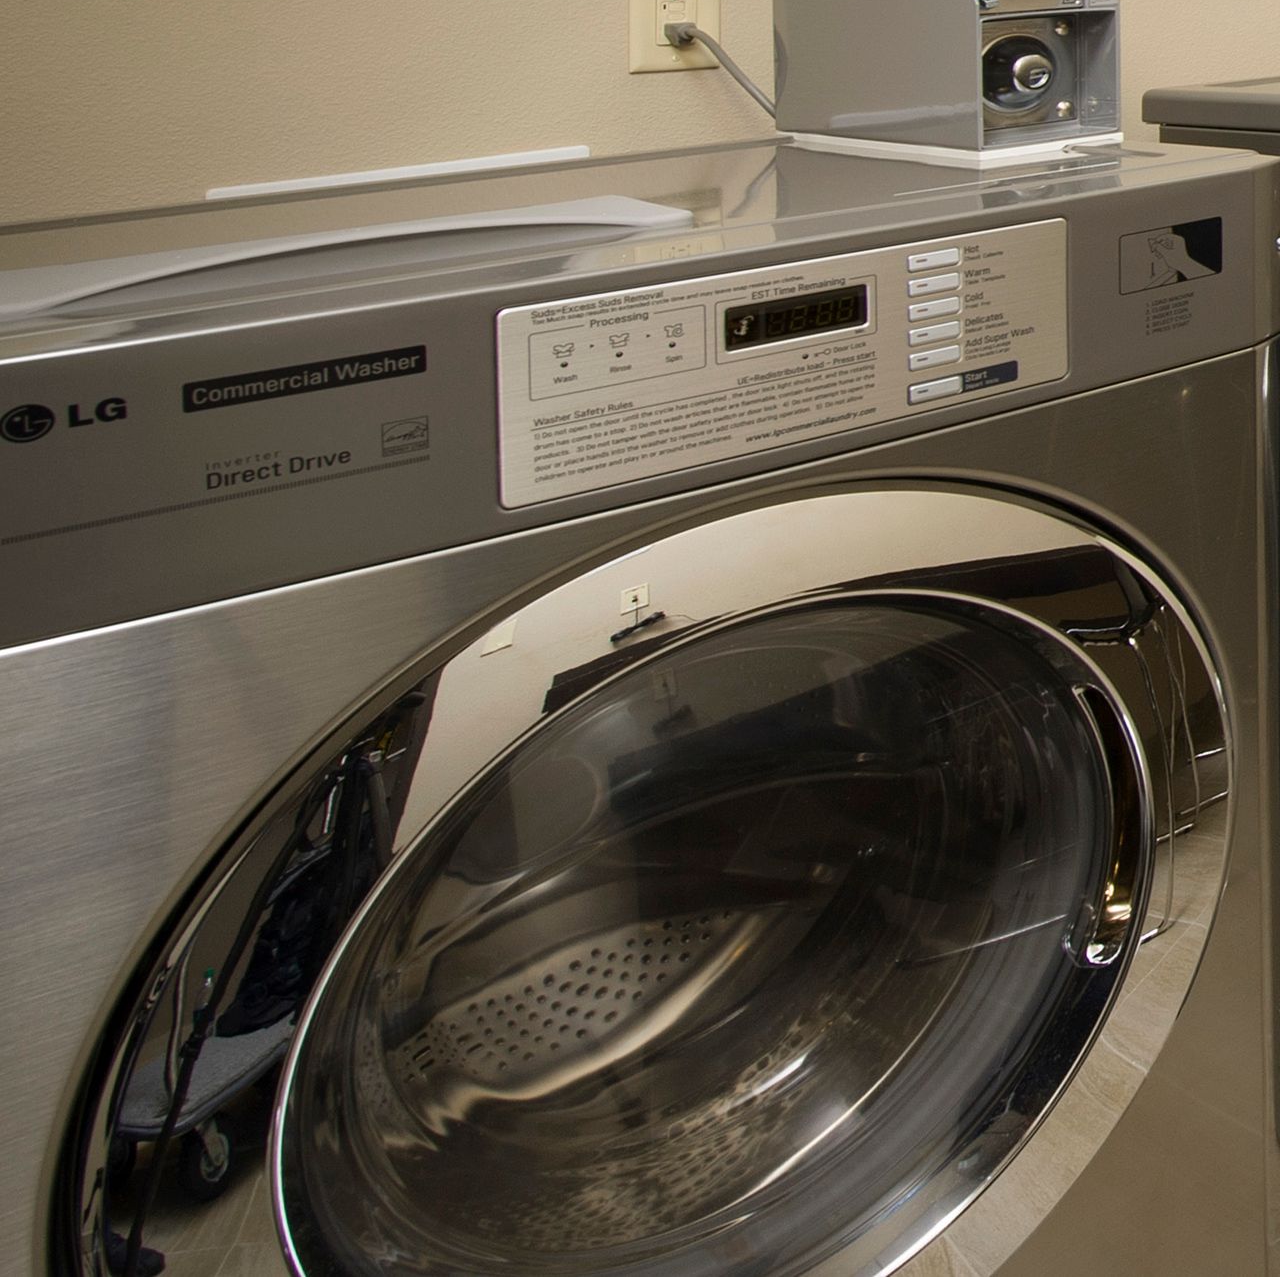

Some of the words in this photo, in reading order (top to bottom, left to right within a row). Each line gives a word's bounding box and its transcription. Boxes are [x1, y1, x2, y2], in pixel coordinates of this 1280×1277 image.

[964, 245, 979, 255] Hot
[964, 267, 990, 279] Warm
[752, 290, 770, 301] EST
[774, 285, 796, 297] Time
[798, 277, 846, 294] Remaining
[965, 292, 983, 303] Cold
[599, 298, 622, 309] Suds
[625, 291, 663, 304] Removal
[590, 311, 648, 330] Processing
[965, 313, 1003, 327] Delicates
[965, 337, 982, 348] Add
[985, 332, 1008, 345] Super
[1011, 326, 1034, 338] Wash
[192, 368, 328, 405] Commercial
[335, 354, 420, 381] Washer
[553, 374, 578, 385] Wash
[965, 371, 988, 383] Start
[68, 397, 127, 428] LG
[534, 413, 571, 428] Washer
[575, 406, 604, 420] Safety
[608, 400, 633, 412] Rules
[206, 462, 282, 490] Direct
[289, 450, 352, 474] Drive
